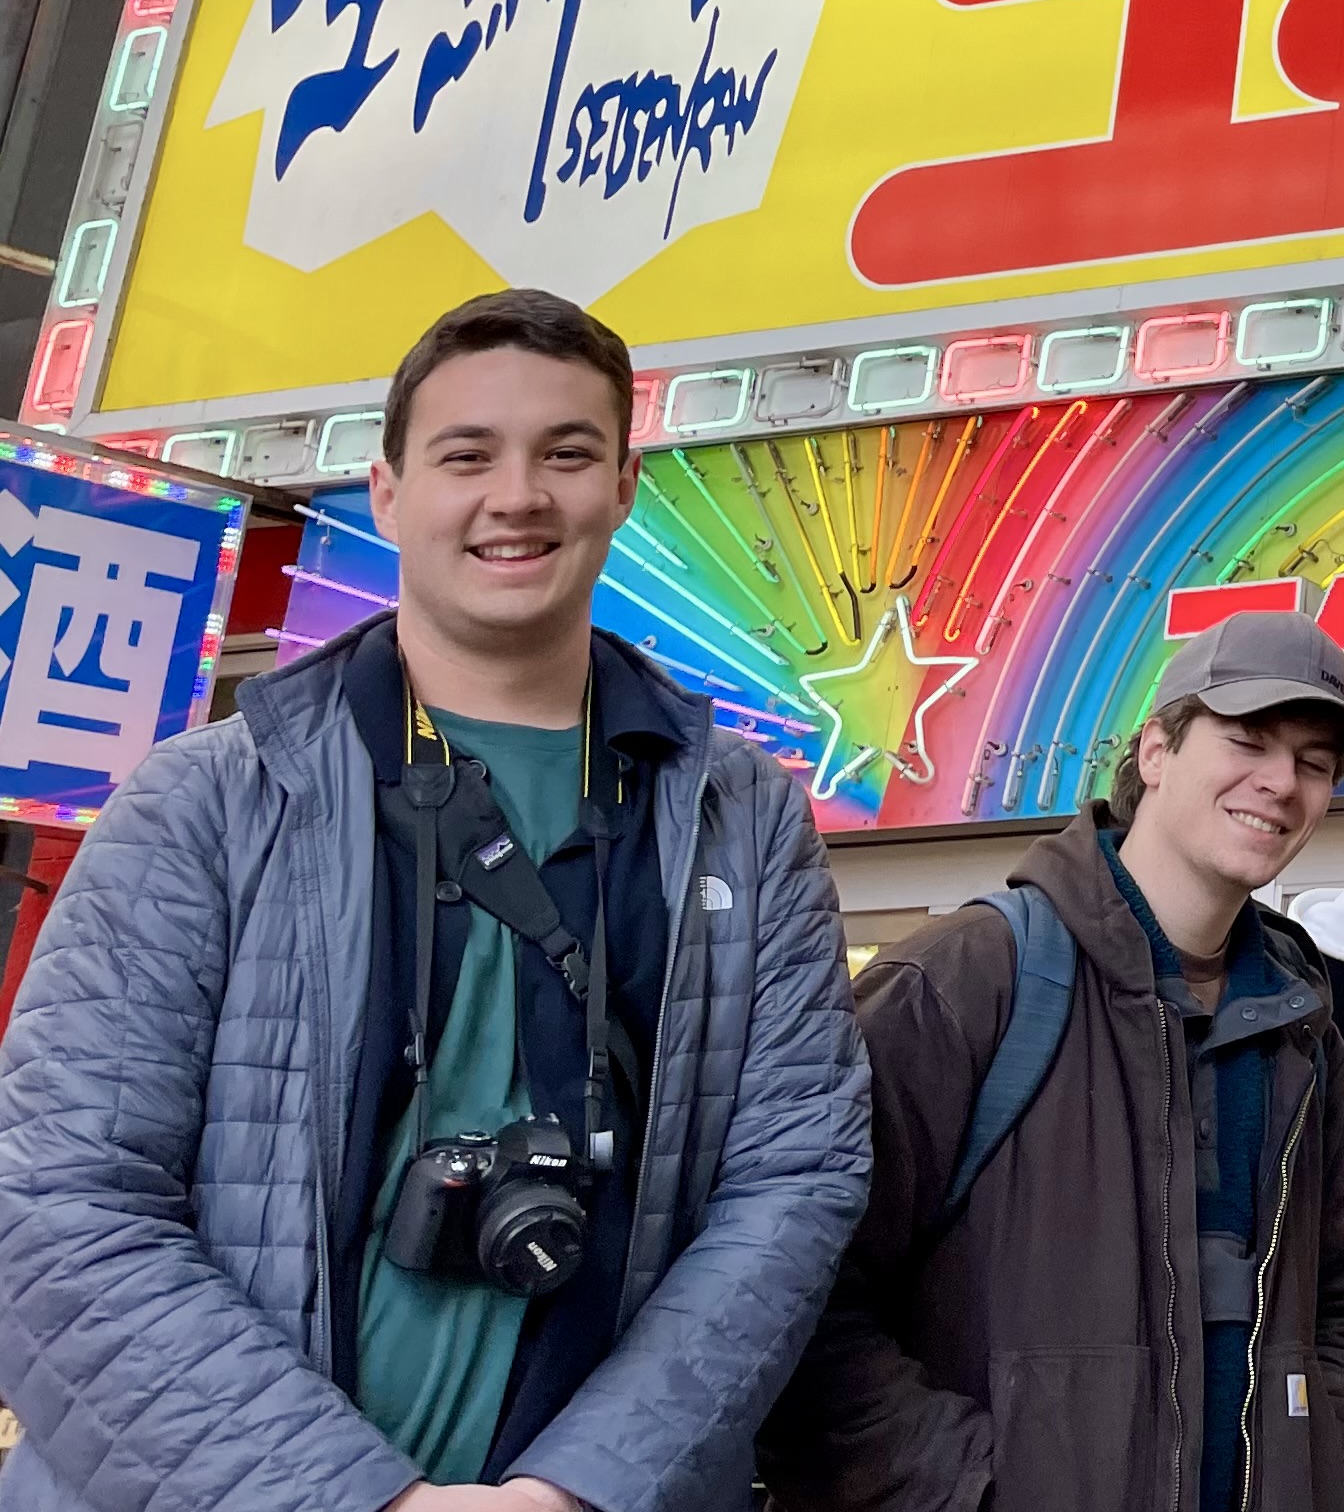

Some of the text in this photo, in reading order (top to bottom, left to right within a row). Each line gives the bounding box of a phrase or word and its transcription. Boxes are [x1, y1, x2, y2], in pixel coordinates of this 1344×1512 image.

[0, 490, 201, 785] 酒
[529, 1154, 567, 1167] Nikon
[526, 1241, 558, 1272] Nikon
